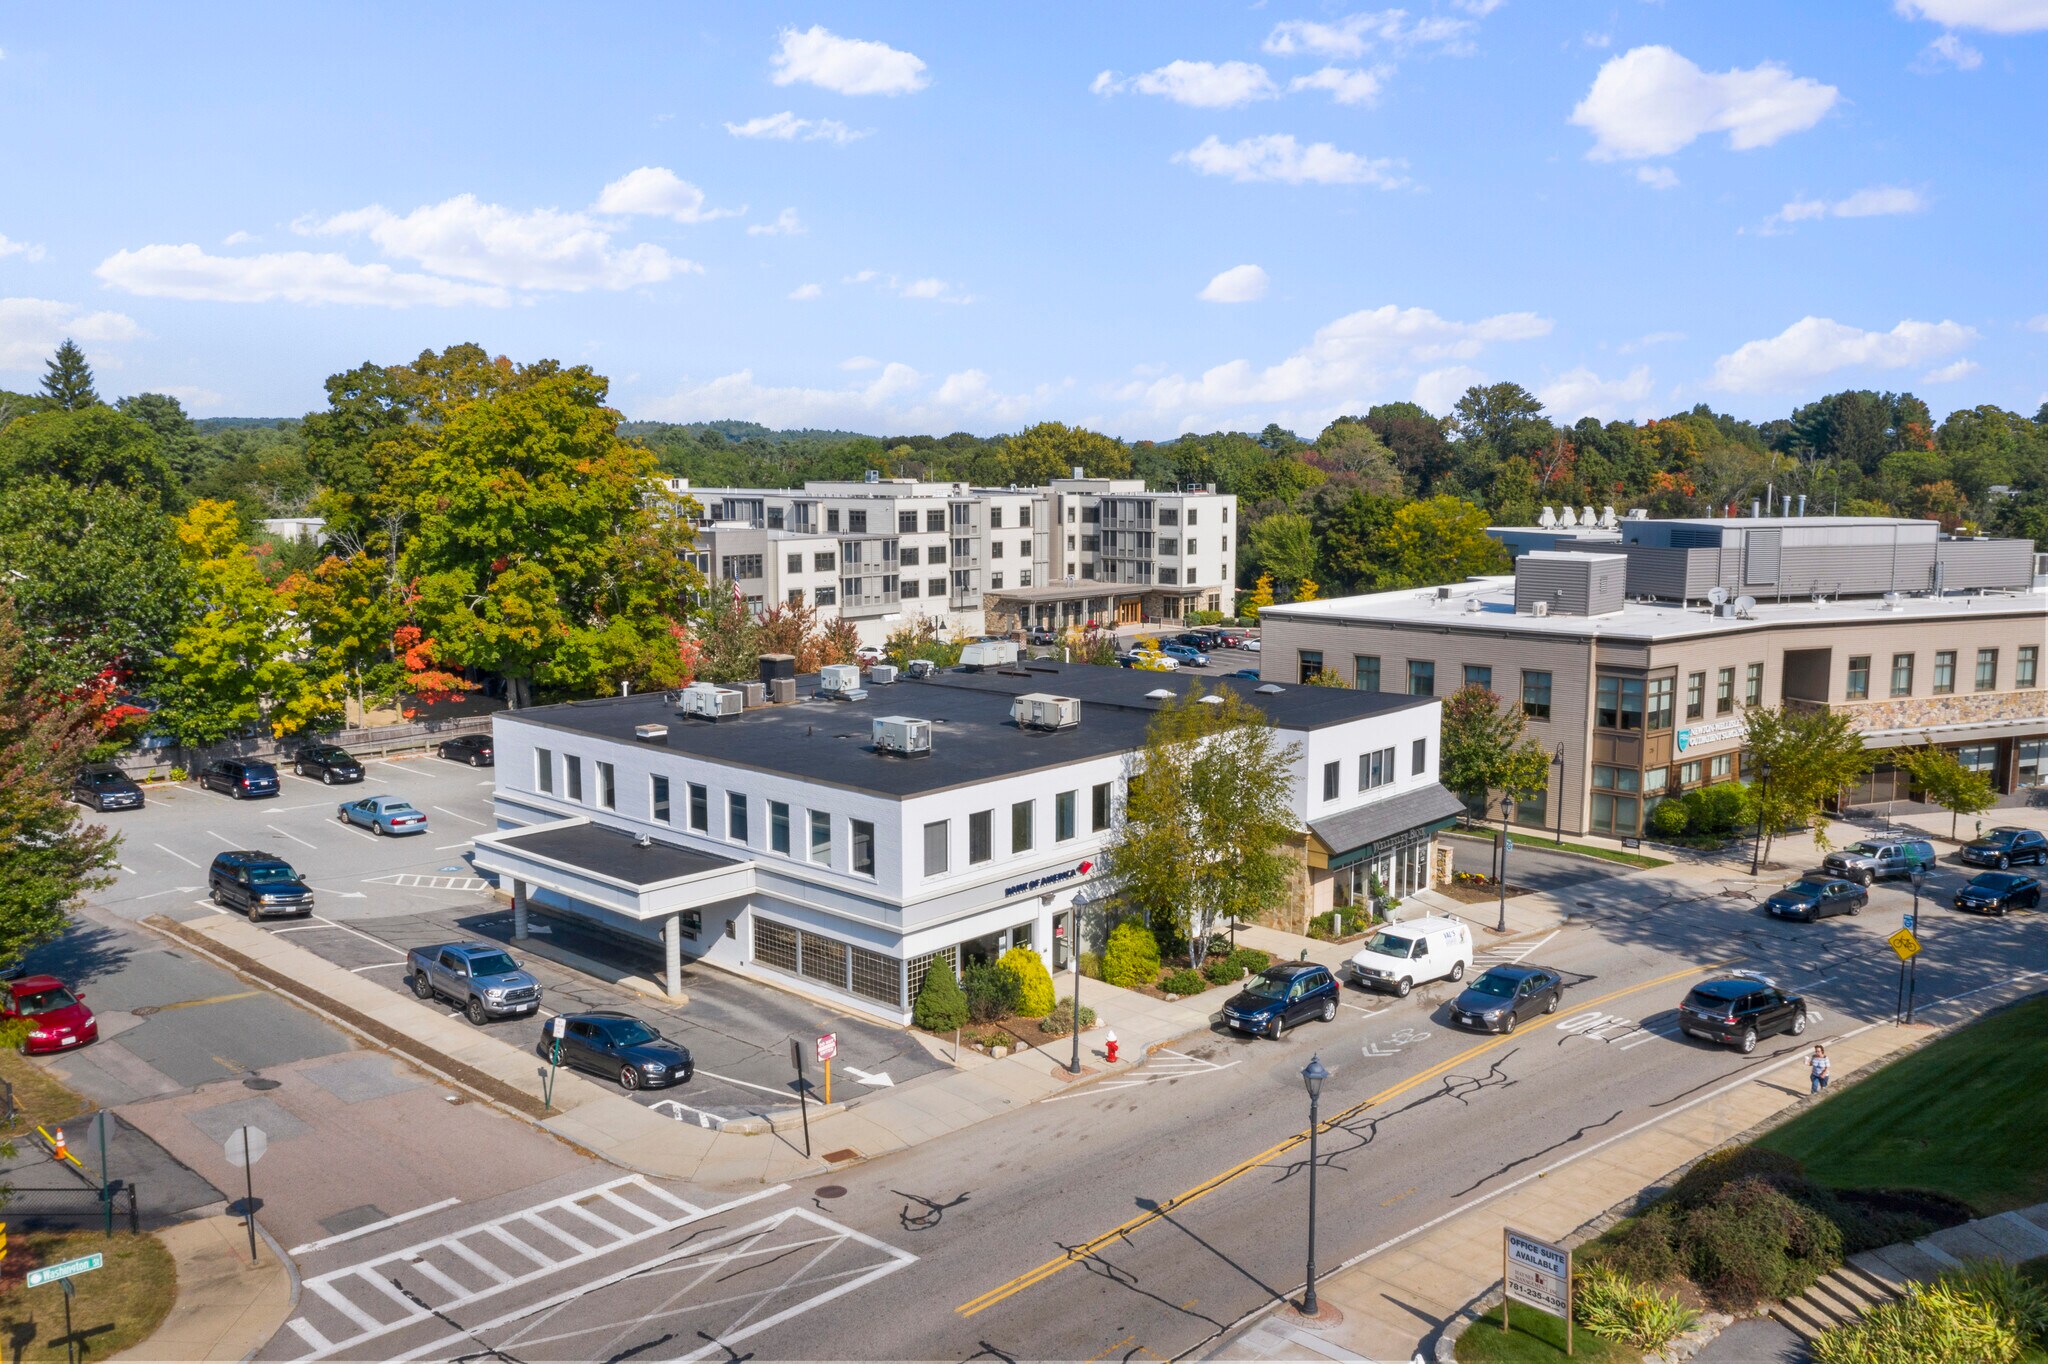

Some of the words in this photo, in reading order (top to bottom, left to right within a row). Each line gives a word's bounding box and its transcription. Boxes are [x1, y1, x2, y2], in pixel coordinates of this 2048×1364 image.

[1005, 882, 1028, 897] BANK
[1029, 879, 1041, 890] OF
[1040, 869, 1077, 888] AMERICA
[1510, 1236, 1539, 1255] OFFICE
[1540, 1247, 1565, 1264] SUITE
[1515, 1250, 1559, 1273] AVAILABLE
[42, 1261, 89, 1281] Washington
[1508, 1281, 1566, 1309] 781-235-4300
